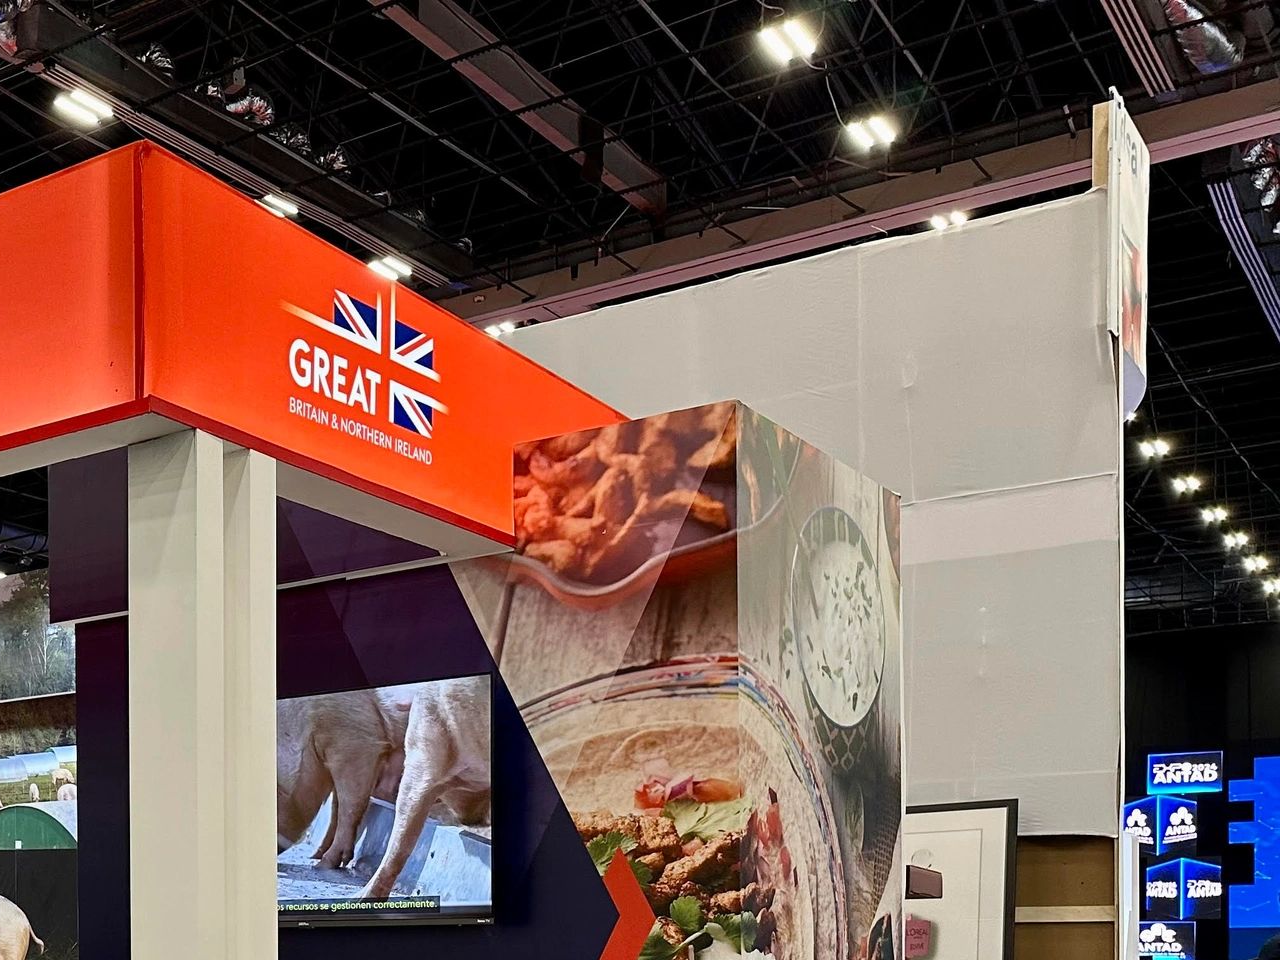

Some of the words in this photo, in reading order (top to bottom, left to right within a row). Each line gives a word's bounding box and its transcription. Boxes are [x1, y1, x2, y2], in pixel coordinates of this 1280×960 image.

[288, 338, 382, 416] GREAT
[289, 396, 329, 426] BRITAIN
[331, 413, 338, 430] &
[340, 418, 392, 449] NORTHERN
[394, 438, 433, 466] IRELAND
[1153, 769, 1218, 784] ANTAD
[1165, 824, 1196, 836] ANTAD
[286, 903, 319, 911] recursos
[331, 900, 371, 913] gestionen
[373, 899, 438, 909] correctamente.
